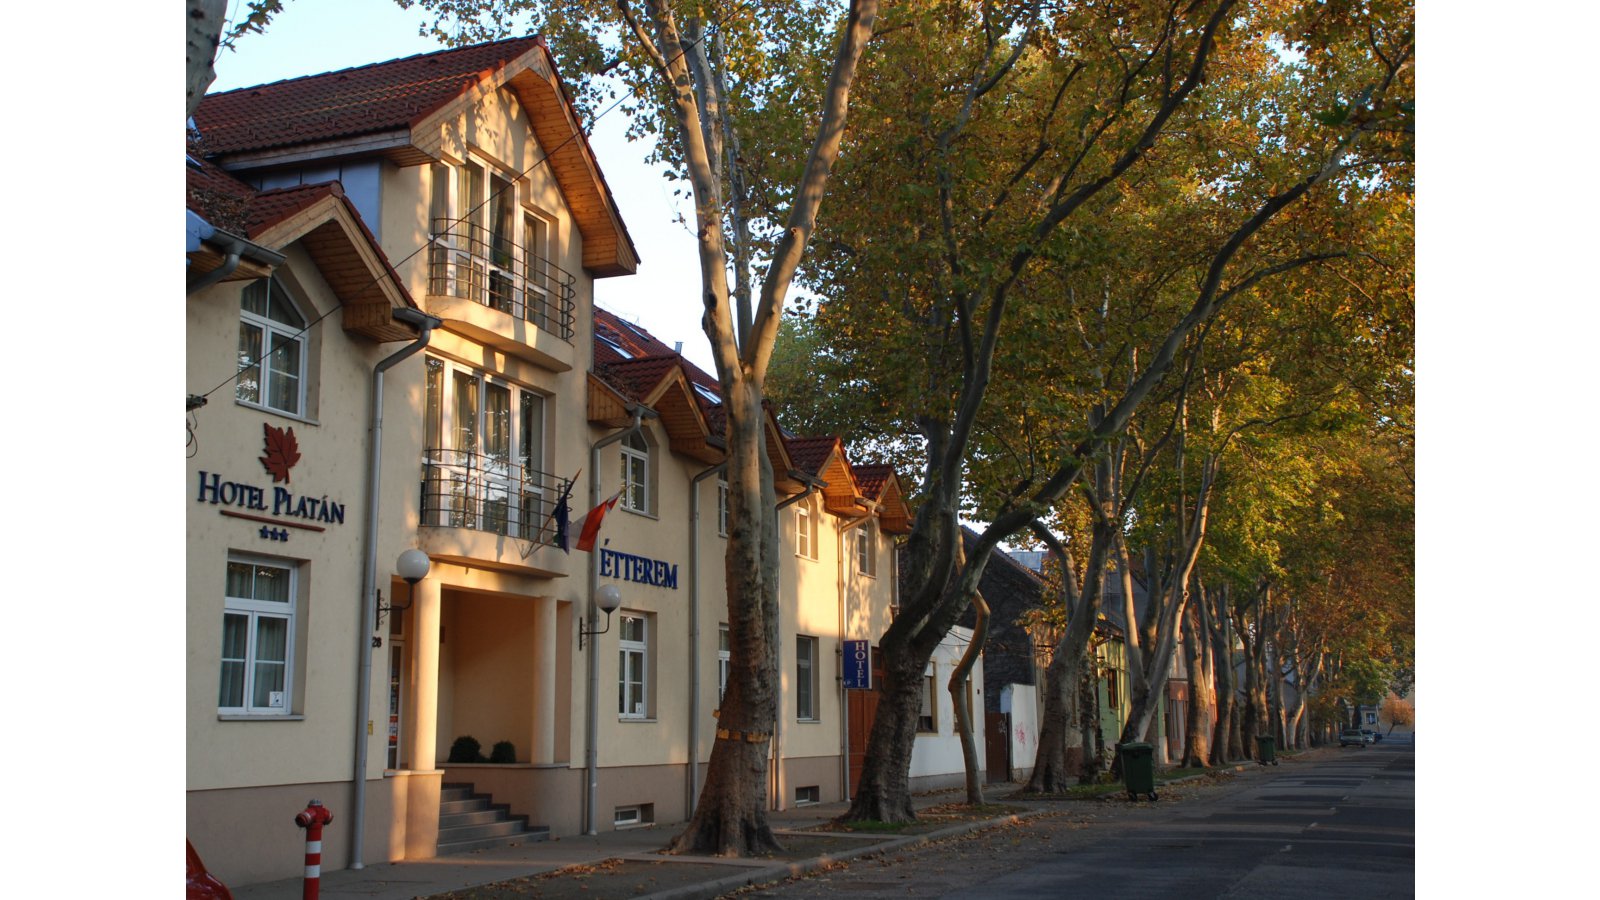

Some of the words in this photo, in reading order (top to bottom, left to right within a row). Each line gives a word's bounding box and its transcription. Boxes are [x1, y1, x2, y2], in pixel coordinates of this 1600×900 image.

[197, 471, 268, 511] HOTEL
[272, 486, 345, 524] PLATÁN
[600, 538, 678, 589] ÉTTEREM
[855, 641, 866, 688] HOTEL
